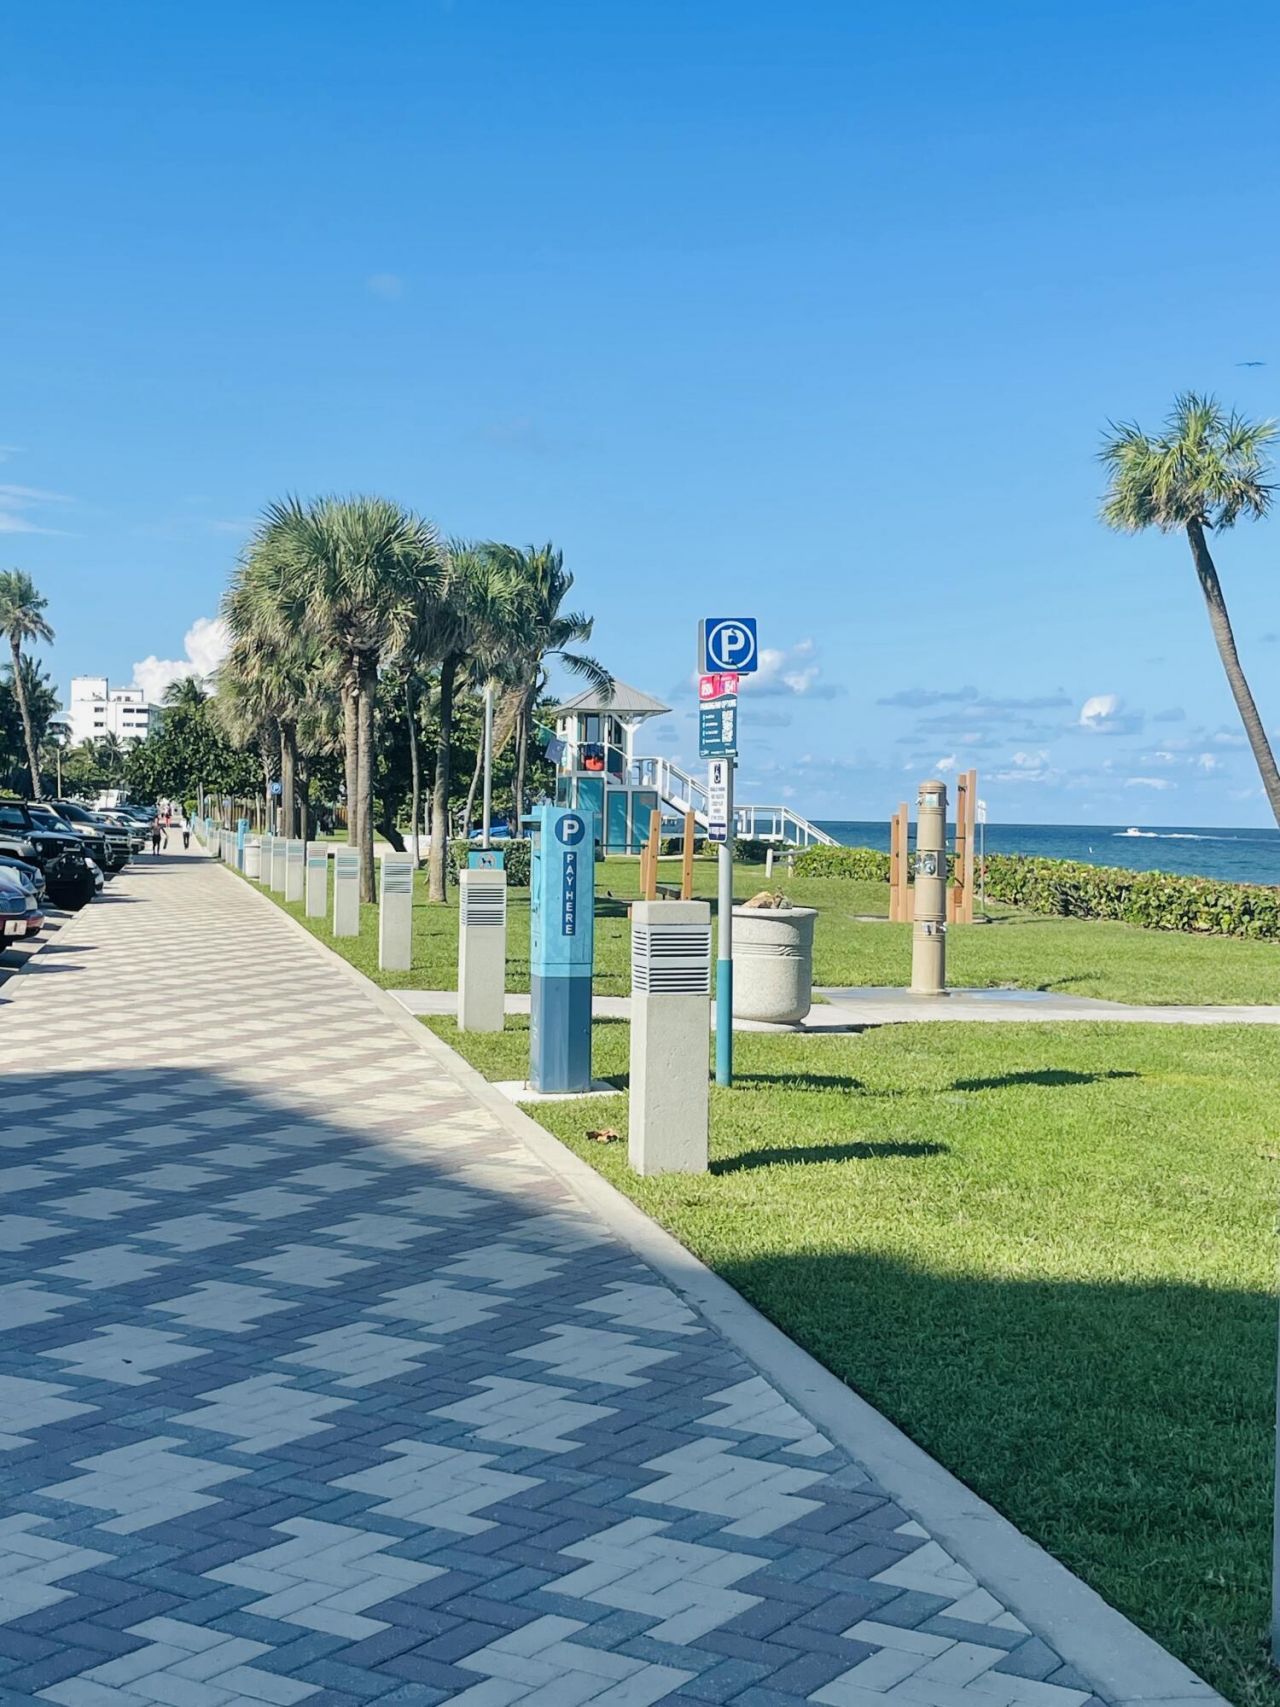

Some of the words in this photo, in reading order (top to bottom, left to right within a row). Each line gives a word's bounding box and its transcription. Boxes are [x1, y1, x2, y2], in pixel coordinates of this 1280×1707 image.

[721, 629, 745, 662] P
[563, 820, 579, 841] P
[566, 854, 574, 886] PAY
[566, 891, 574, 934] HERE
